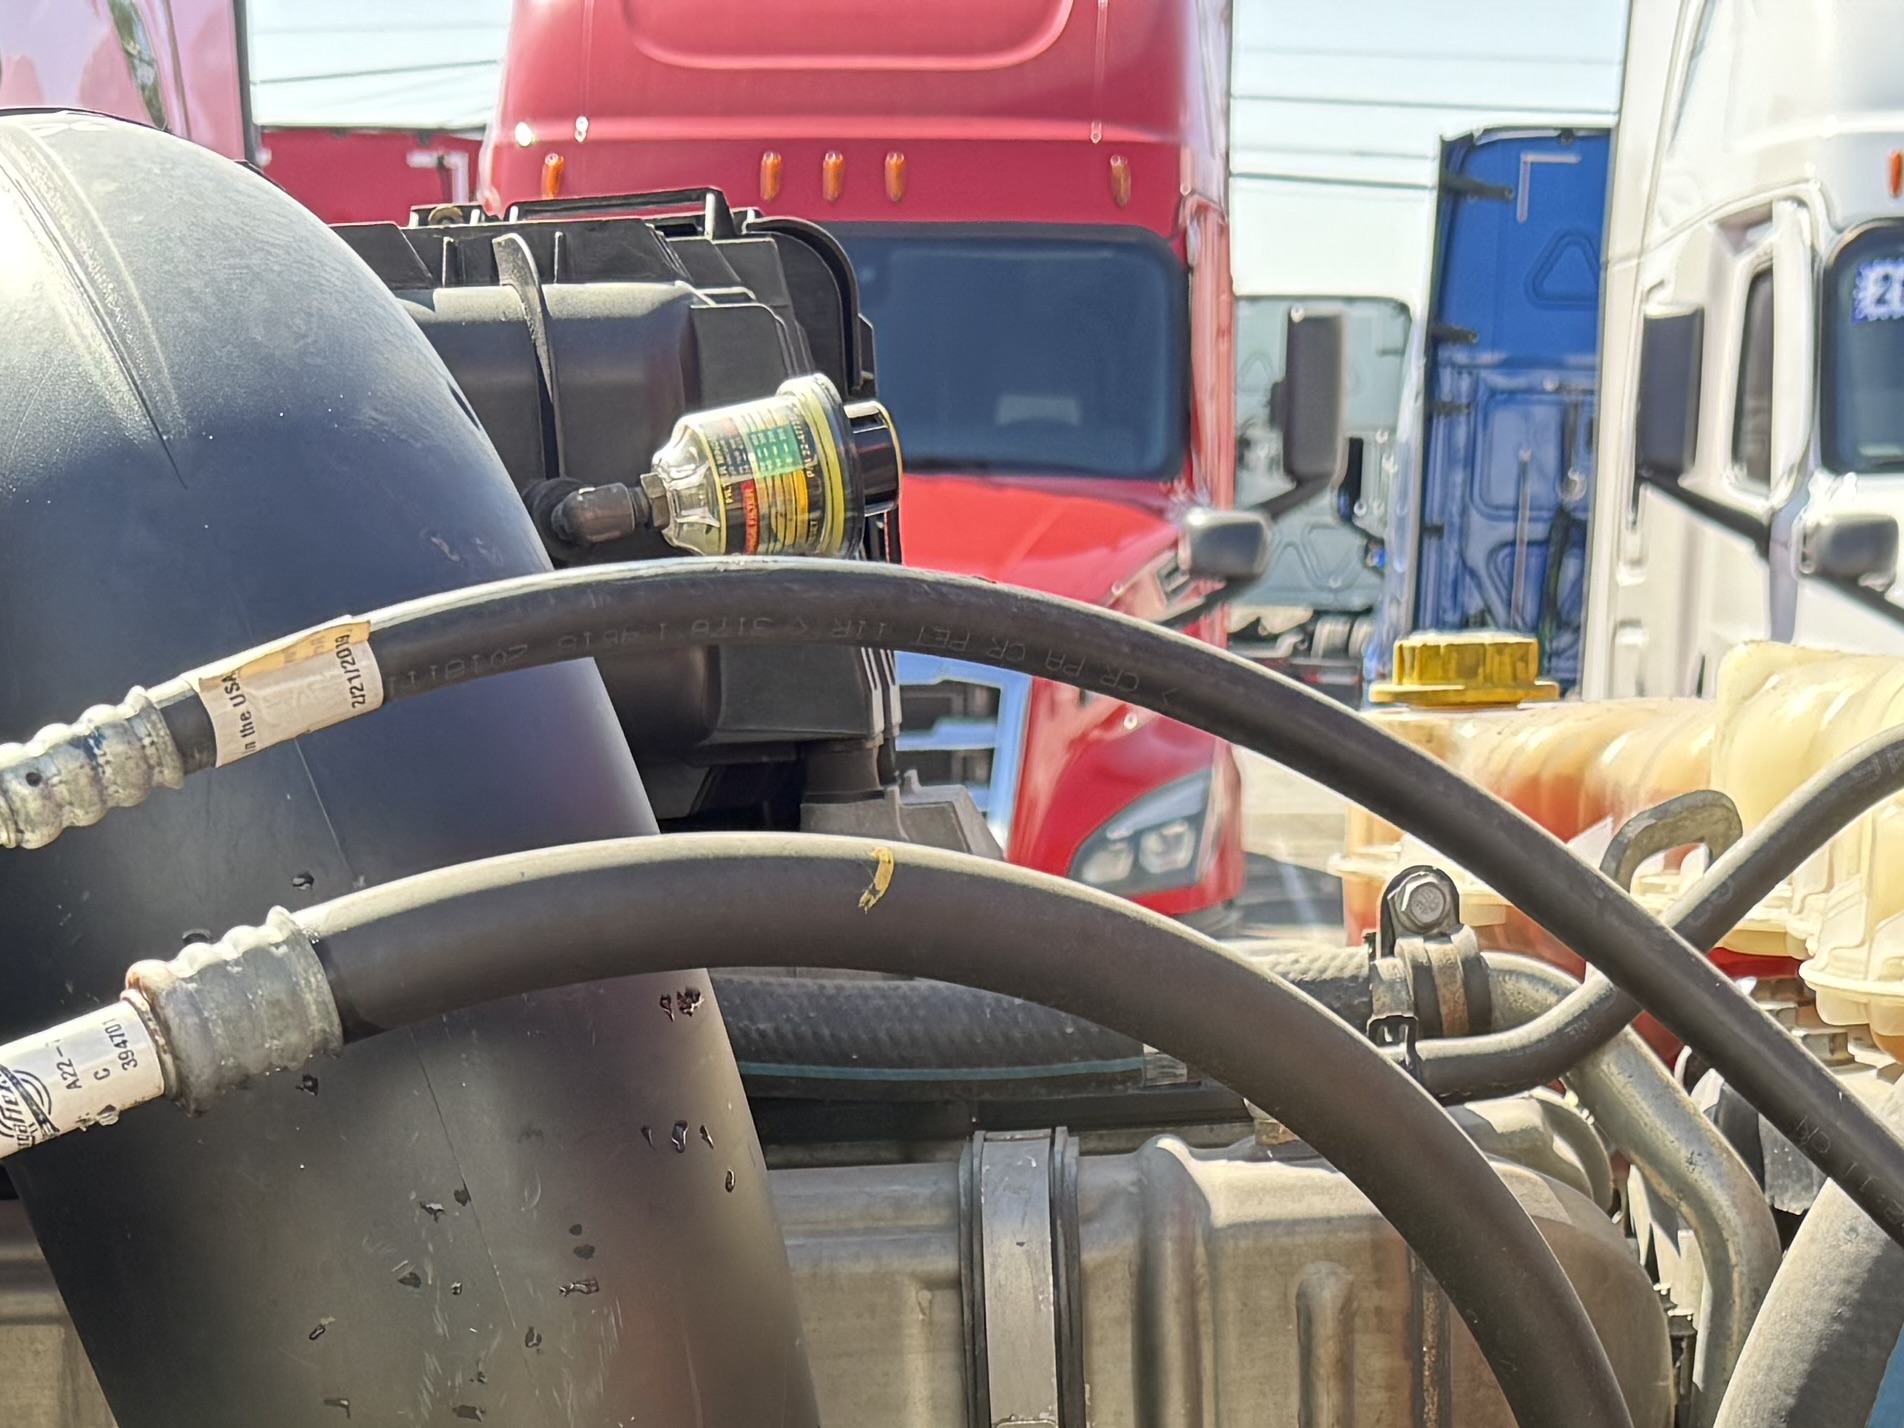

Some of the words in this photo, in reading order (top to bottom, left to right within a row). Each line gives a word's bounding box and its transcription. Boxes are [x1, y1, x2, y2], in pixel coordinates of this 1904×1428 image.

[914, 625, 973, 652] PET
[334, 634, 367, 709] 2/21/2019
[1045, 648, 1084, 678] PA
[221, 669, 247, 707] USA
[1101, 664, 1139, 692] CR
[238, 710, 256, 738] the
[93, 1067, 111, 1082] C
